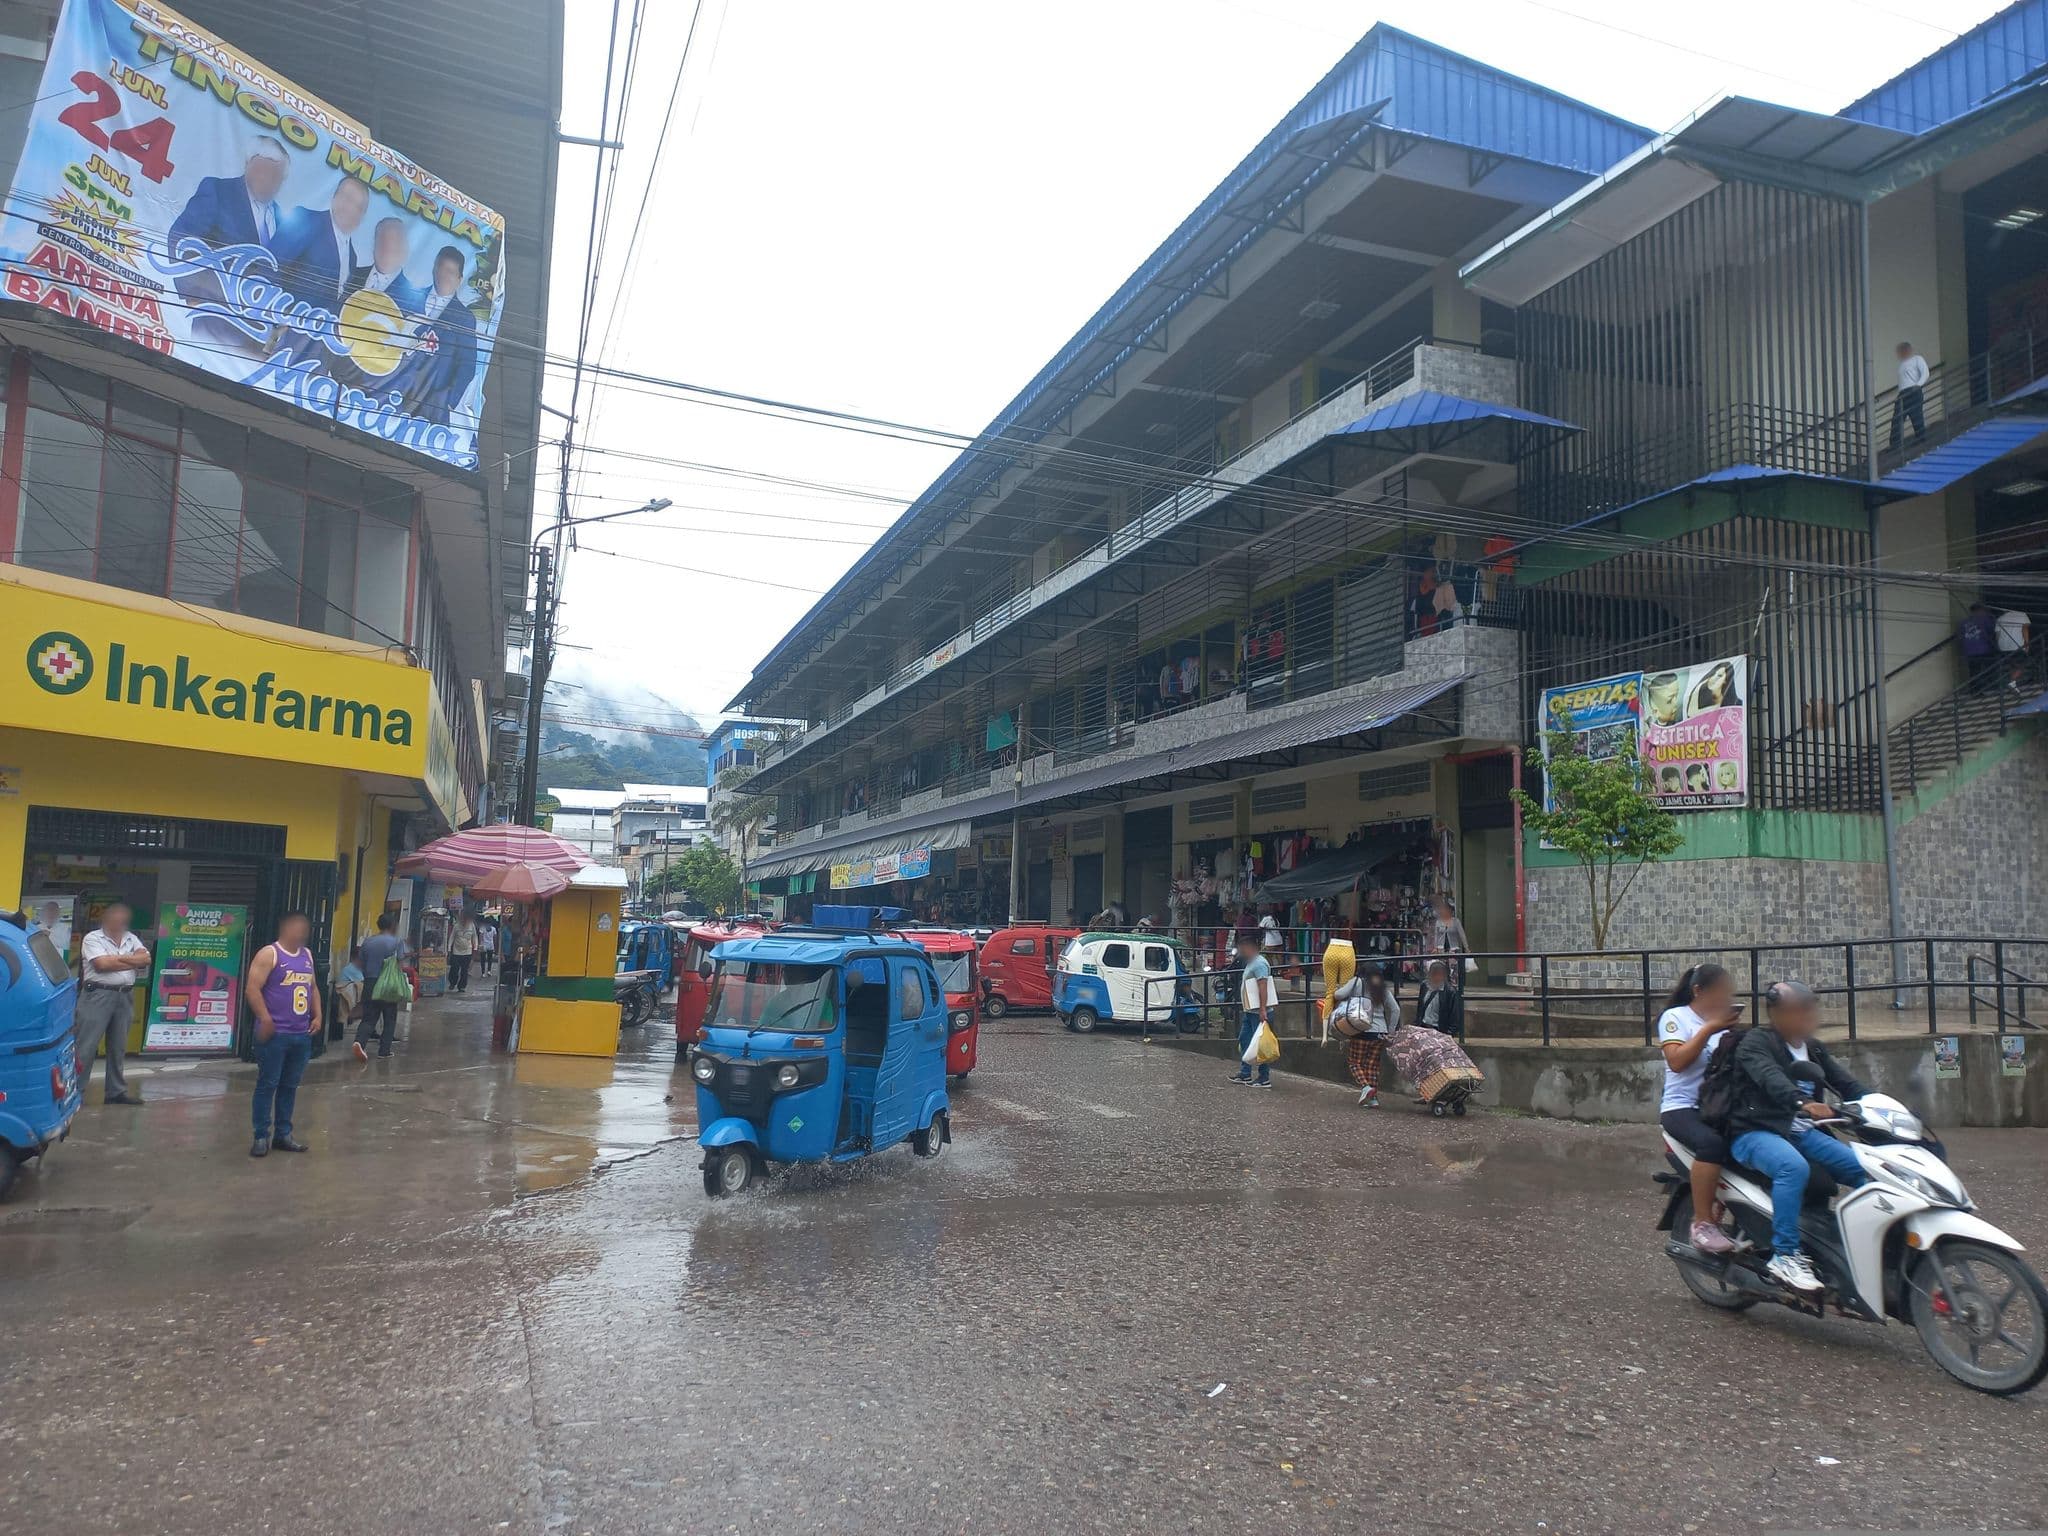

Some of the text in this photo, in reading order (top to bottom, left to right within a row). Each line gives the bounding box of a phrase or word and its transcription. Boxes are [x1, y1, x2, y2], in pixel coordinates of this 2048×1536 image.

[58, 71, 175, 184] 24
[131, 19, 485, 249] TINGO MARIA
[135, 1, 164, 28] EL
[169, 23, 230, 68] AGUA
[234, 62, 281, 96] MAS
[284, 91, 330, 129] RICA
[332, 119, 374, 149] DEL
[369, 139, 417, 178] PERÚ
[419, 174, 477, 213] VUELVE
[63, 163, 133, 221] 3PM
[86, 154, 133, 197] JUN.
[26, 242, 163, 326] ARENA
[40, 225, 162, 292] CENTRO DE ESPARCIMIENTO
[5, 265, 173, 355] BAMBÚ
[148, 236, 357, 356] Agua
[237, 348, 479, 471] Marina
[105, 641, 412, 747] Inkafarma
[1549, 680, 1637, 713] OFERTAS
[1654, 720, 1725, 745] ESTETICA
[1656, 741, 1719, 762] UNISEX
[186, 909, 222, 919] ANIVER
[188, 918, 218, 927] SARIO
[171, 949, 228, 958] 100 PREMIOS
[293, 985, 307, 1015] 6
